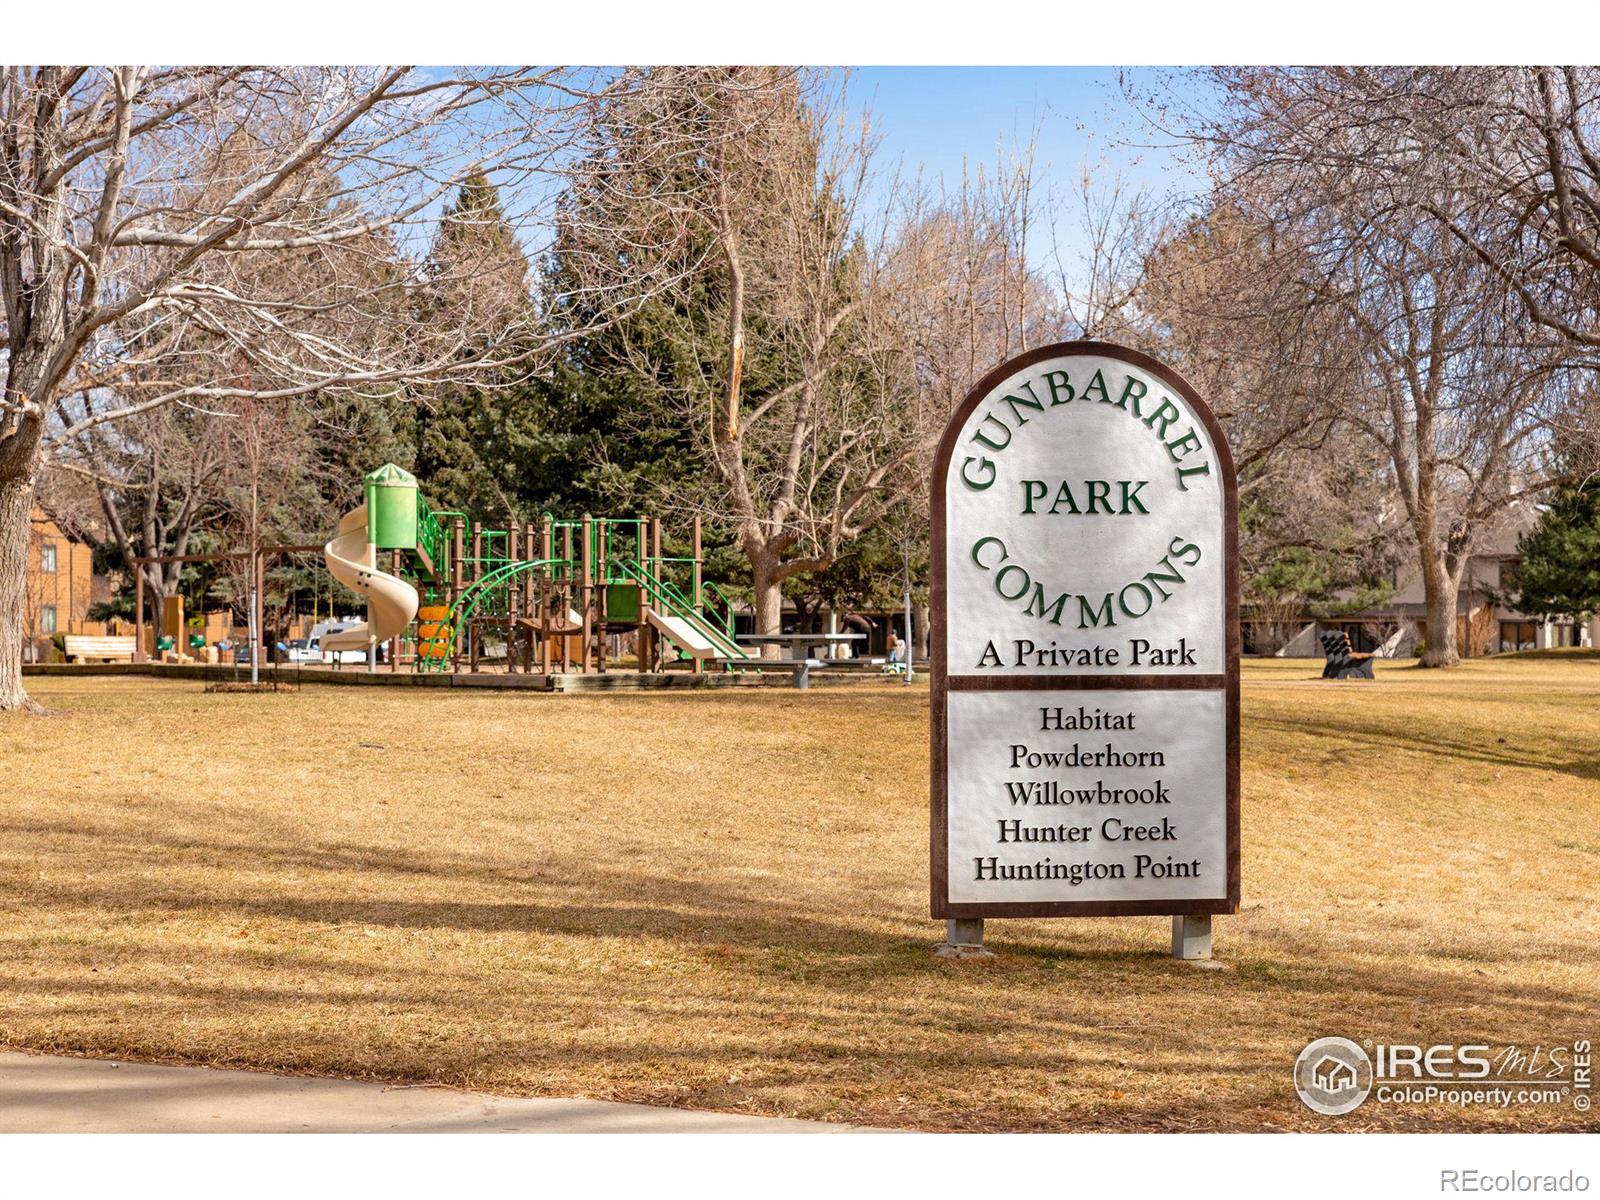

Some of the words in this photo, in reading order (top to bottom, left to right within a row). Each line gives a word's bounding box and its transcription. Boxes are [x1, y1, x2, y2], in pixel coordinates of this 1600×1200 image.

[960, 368, 1210, 492] GUNBARREL
[1020, 480, 1150, 515] PARK
[970, 536, 1202, 629] COMMONS
[975, 639, 1004, 668] A
[1013, 639, 1120, 668] Private
[1128, 638, 1197, 667] Park
[1039, 707, 1136, 731] Habitat
[1008, 743, 1166, 769] Powderhorn
[1003, 780, 1171, 806] Willowbrook
[997, 818, 1093, 843] Hunter
[1101, 817, 1178, 842] Creek
[973, 856, 1126, 885] Huntington
[1133, 854, 1202, 878] Point
